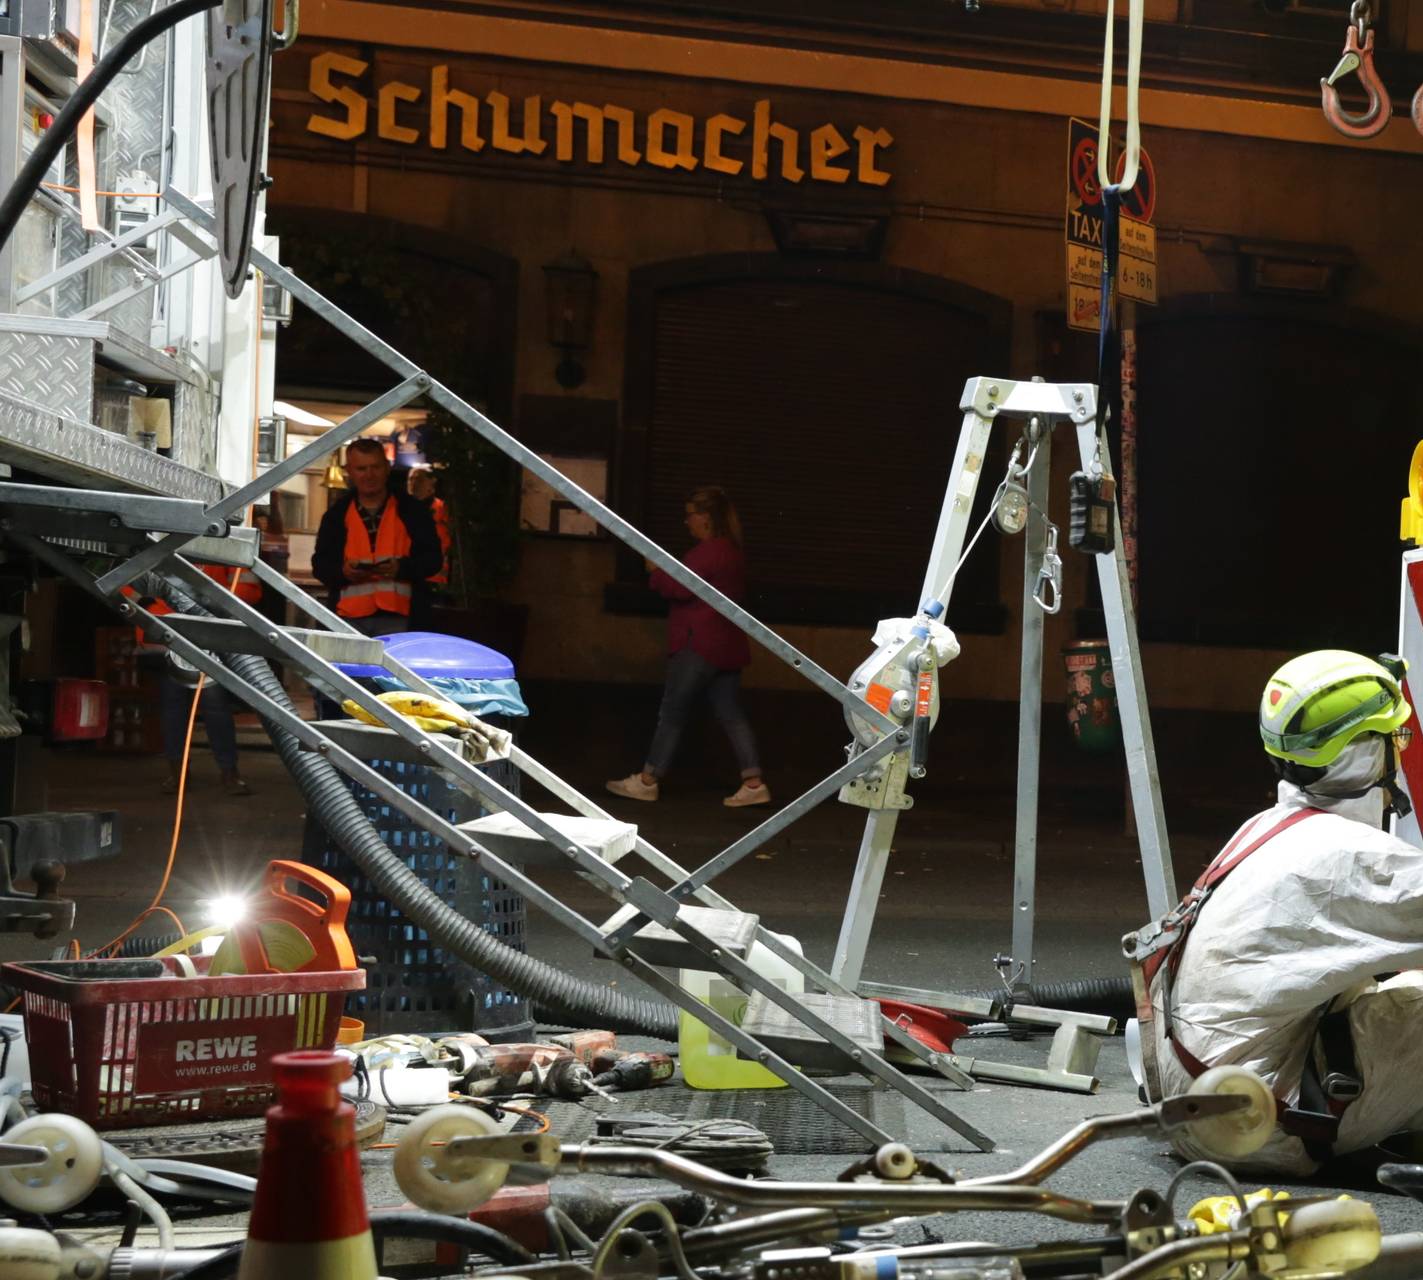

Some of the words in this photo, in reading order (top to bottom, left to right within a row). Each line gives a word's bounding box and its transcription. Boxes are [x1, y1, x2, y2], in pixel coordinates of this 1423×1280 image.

[307, 51, 894, 187] Schumacher
[1070, 209, 1105, 246] TAX
[176, 1035, 257, 1062] REWE
[175, 1061, 257, 1077] www.rewe.de
